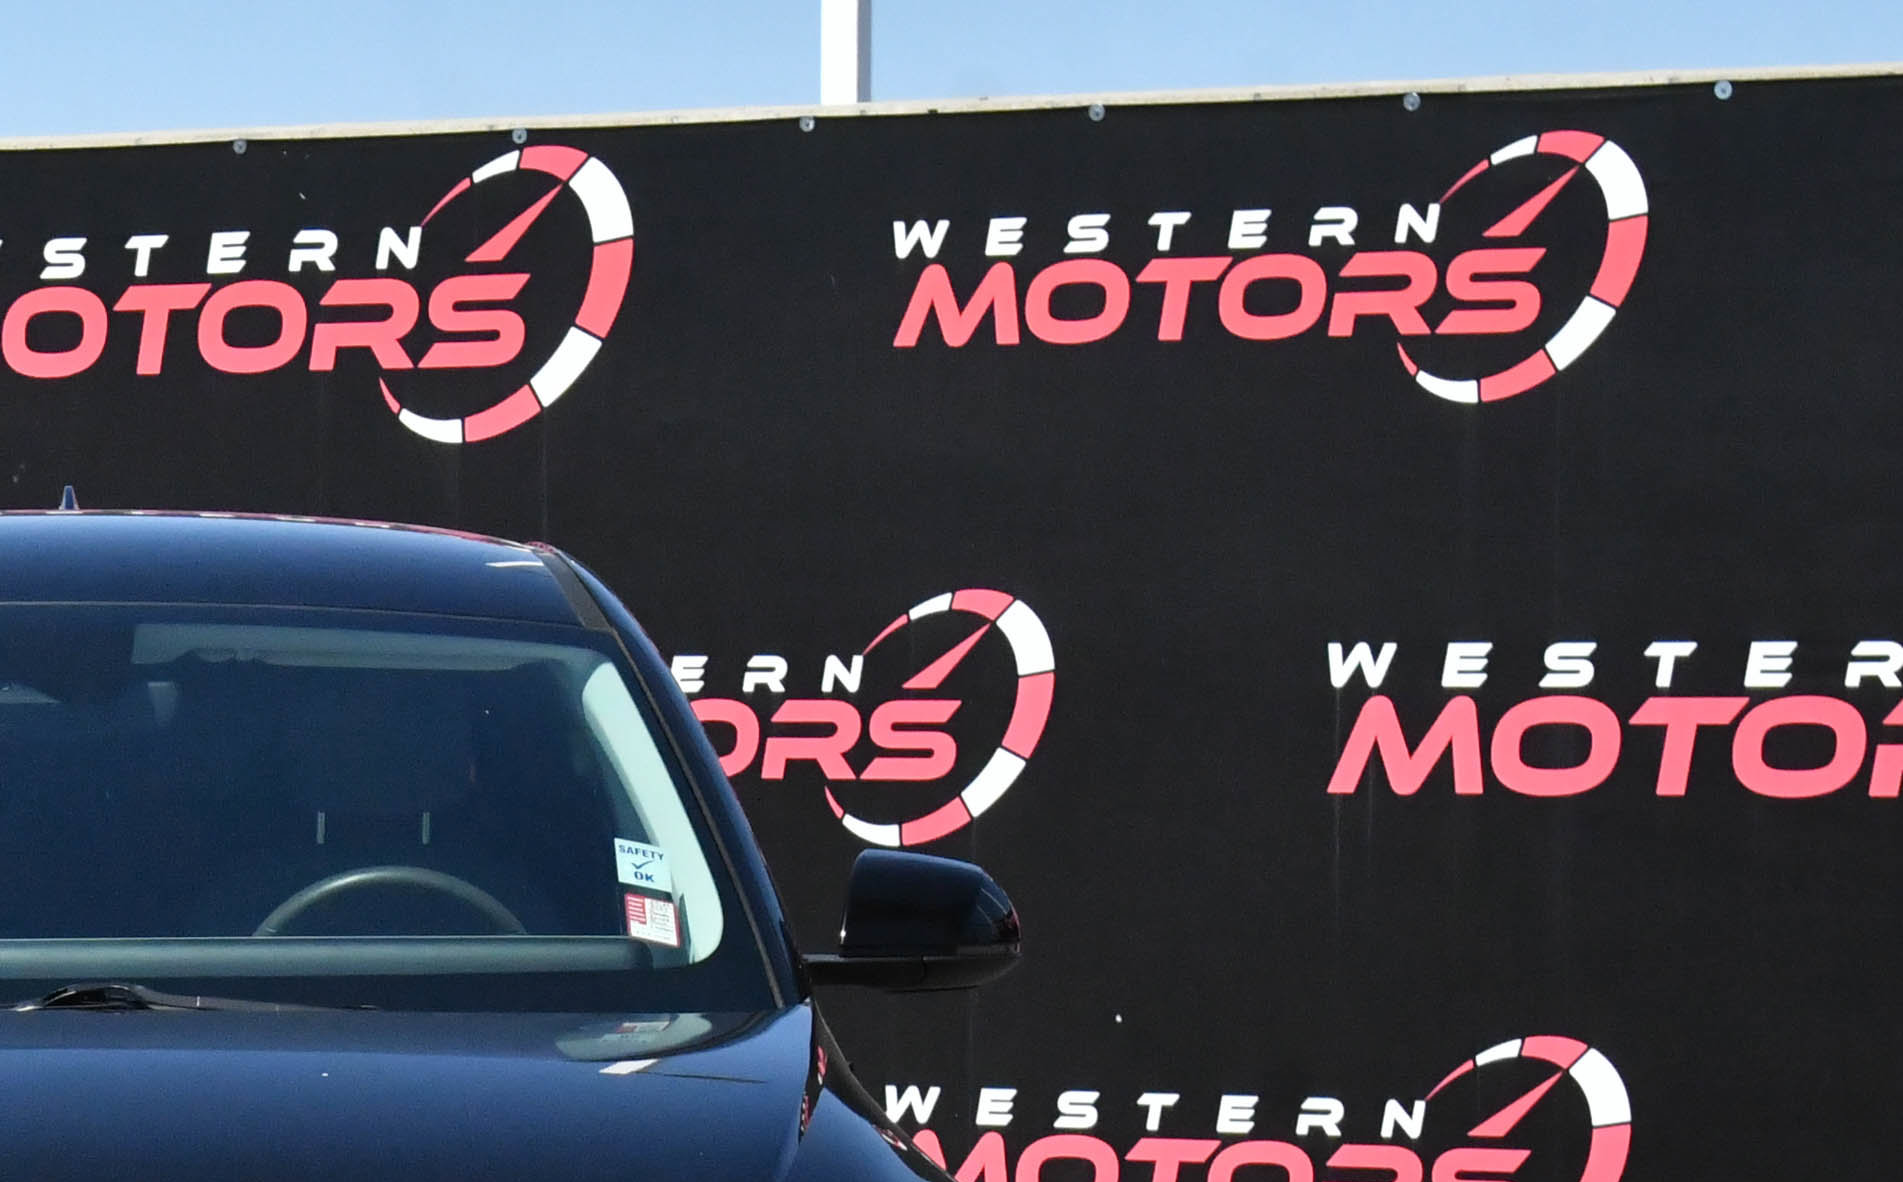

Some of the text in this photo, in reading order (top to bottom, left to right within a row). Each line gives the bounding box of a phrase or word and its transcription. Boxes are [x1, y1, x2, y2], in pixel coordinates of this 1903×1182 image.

[893, 202, 1441, 260] WESTERN
[893, 247, 1547, 348] MOTORS
[670, 654, 864, 693] ERN
[1327, 640, 1903, 689] WESTER
[618, 844, 664, 860] SAFETY
[634, 871, 655, 883] OK
[884, 1084, 1427, 1141] WESTERN
